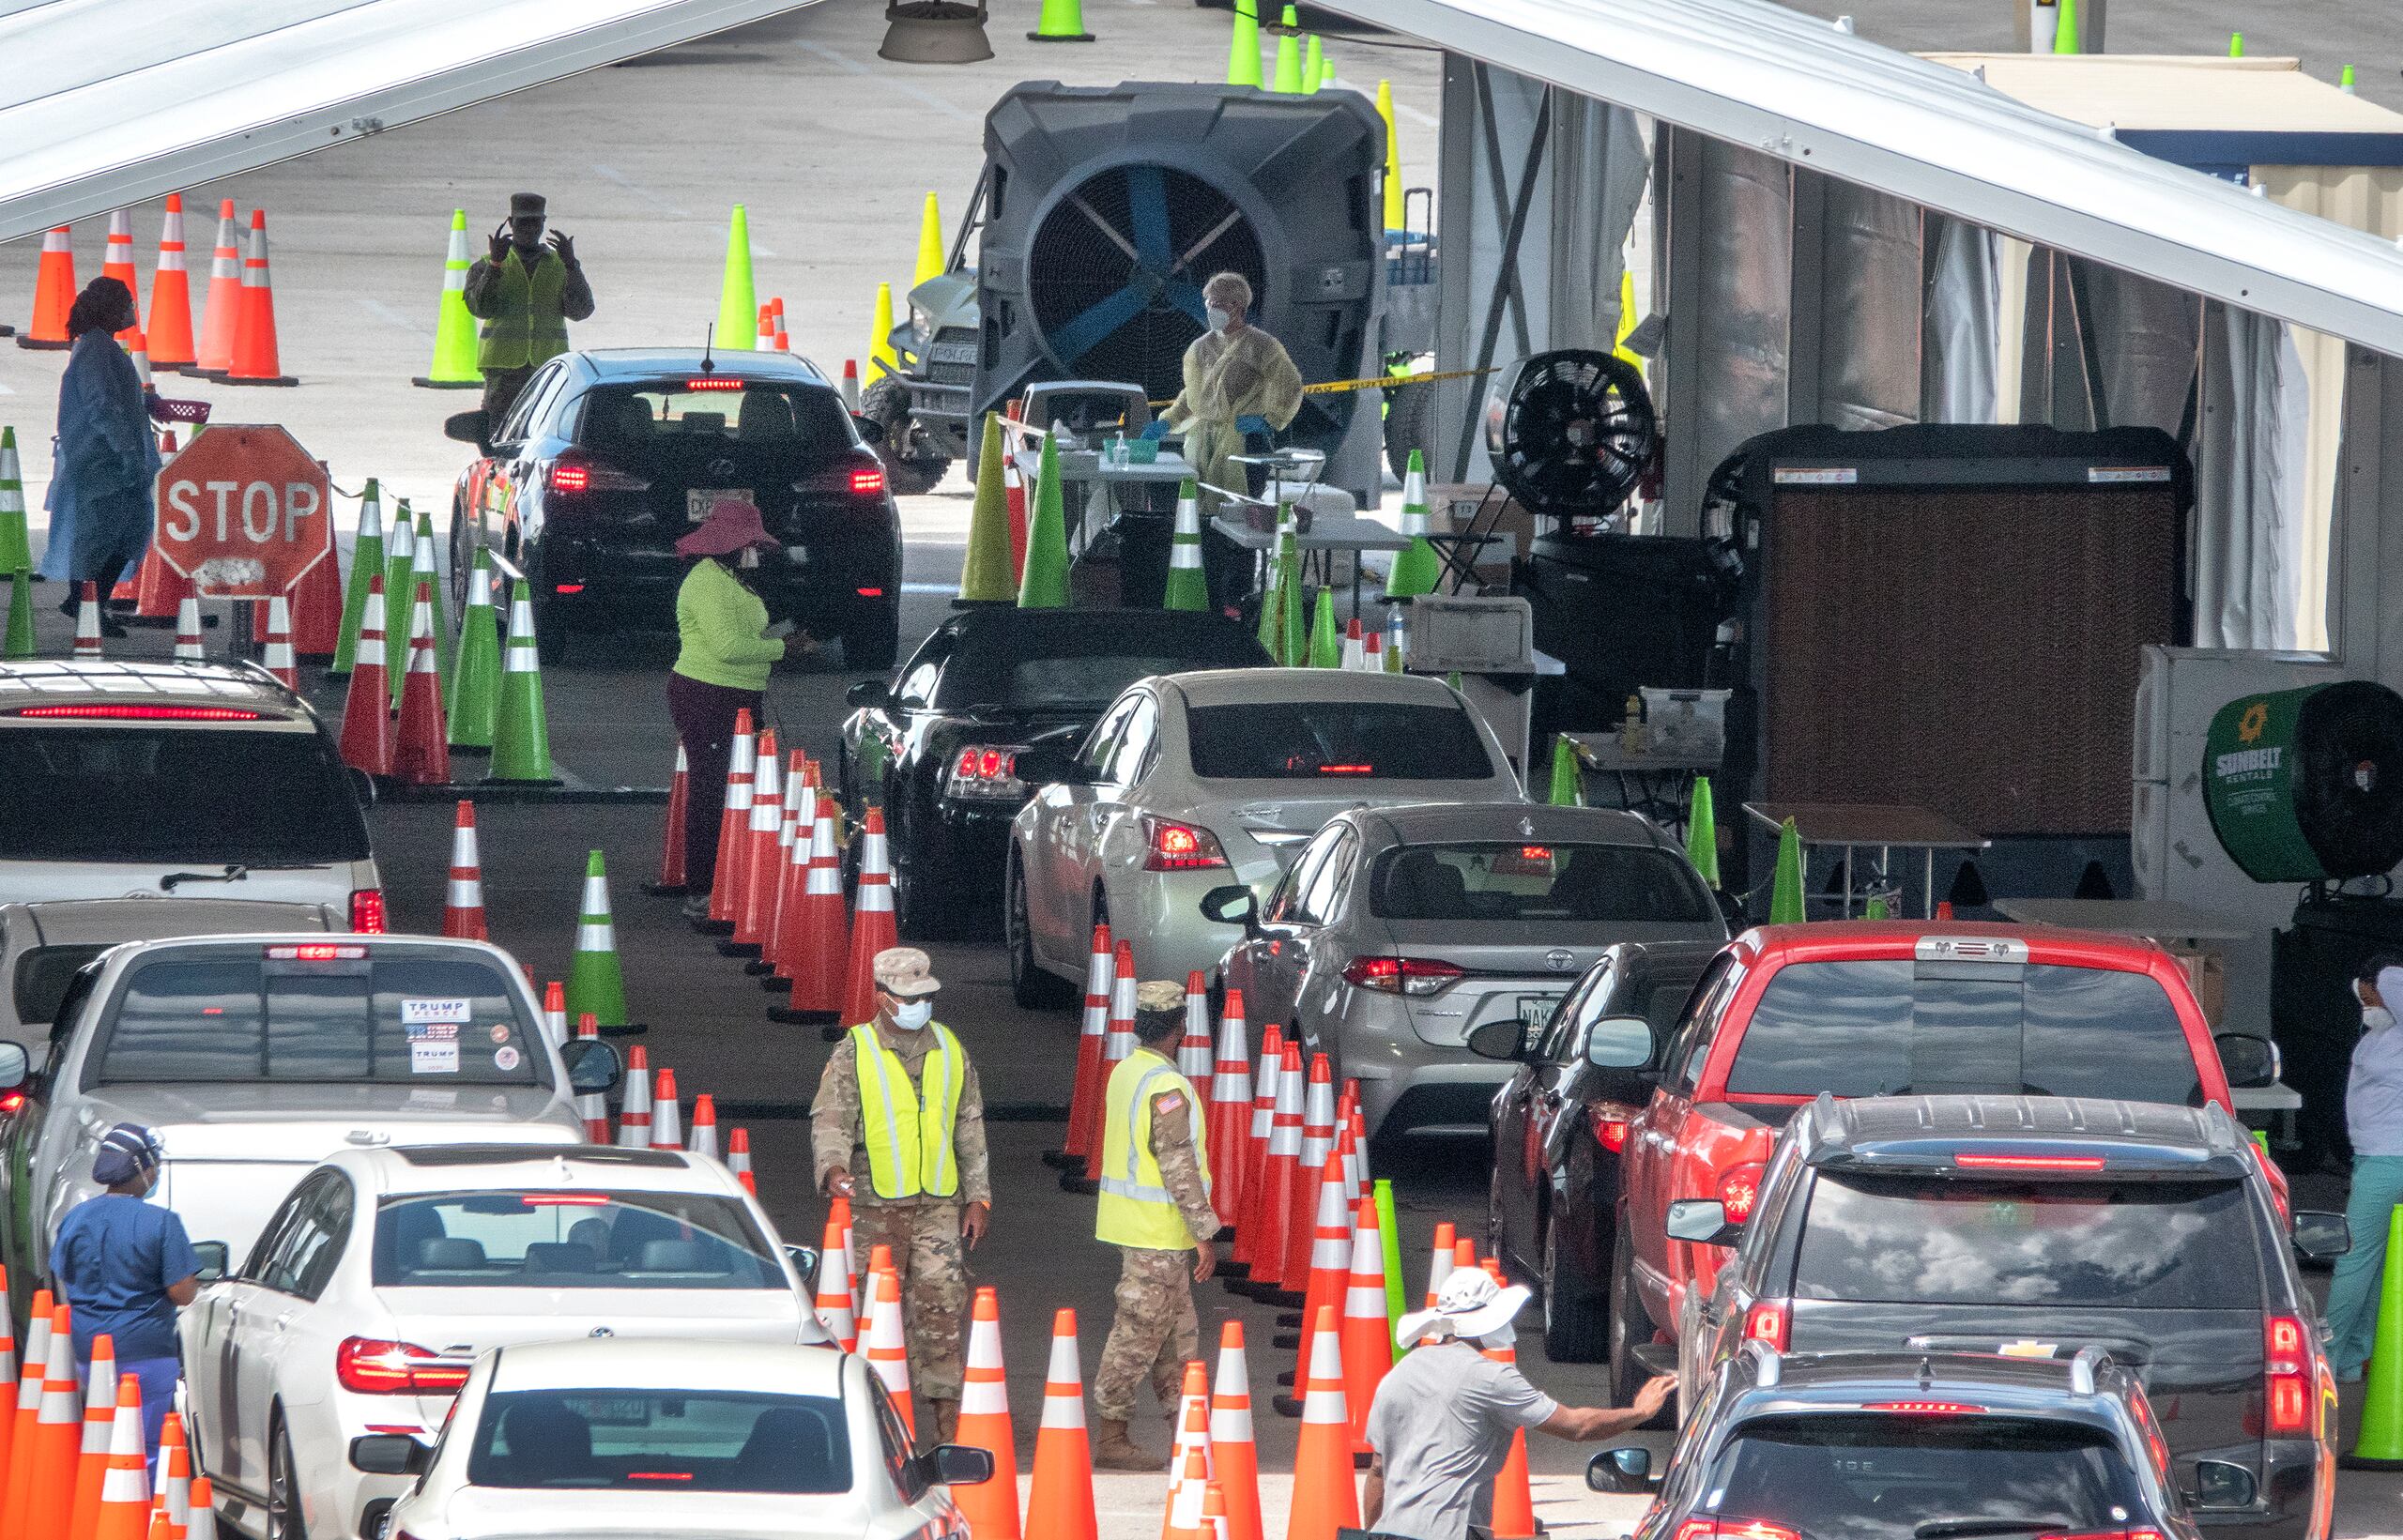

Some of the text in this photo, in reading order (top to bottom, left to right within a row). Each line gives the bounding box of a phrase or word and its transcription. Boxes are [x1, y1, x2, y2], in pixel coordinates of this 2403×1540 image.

[166, 480, 320, 542] STOP
[2216, 747, 2282, 777] SUNBELT
[2226, 770, 2273, 785] RENTALS
[409, 1002, 464, 1011] TRUMP
